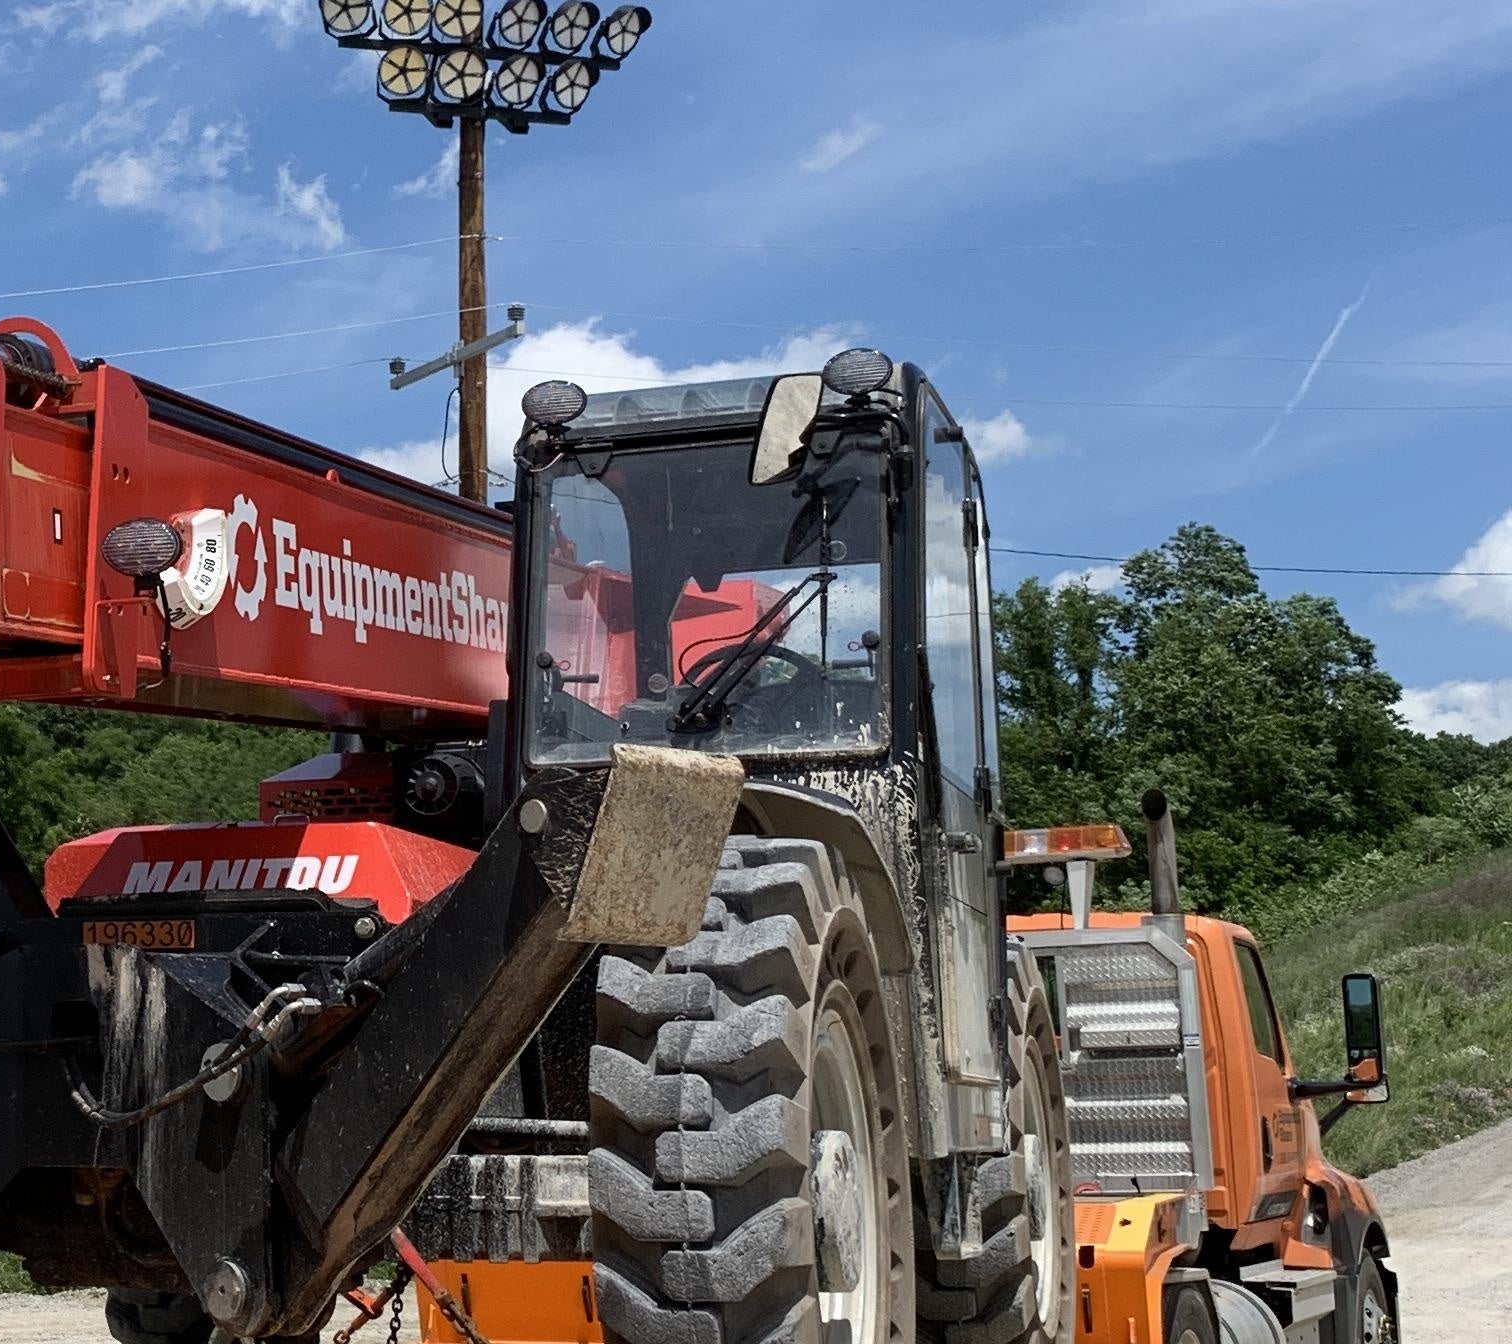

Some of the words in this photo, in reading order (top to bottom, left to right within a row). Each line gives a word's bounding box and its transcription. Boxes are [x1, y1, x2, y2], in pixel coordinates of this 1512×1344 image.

[206, 539, 217, 553] 80
[204, 559, 216, 572] 60
[272, 518, 508, 654] EquipmentShar
[122, 855, 359, 895] MANITOU
[87, 921, 194, 948] 196330
